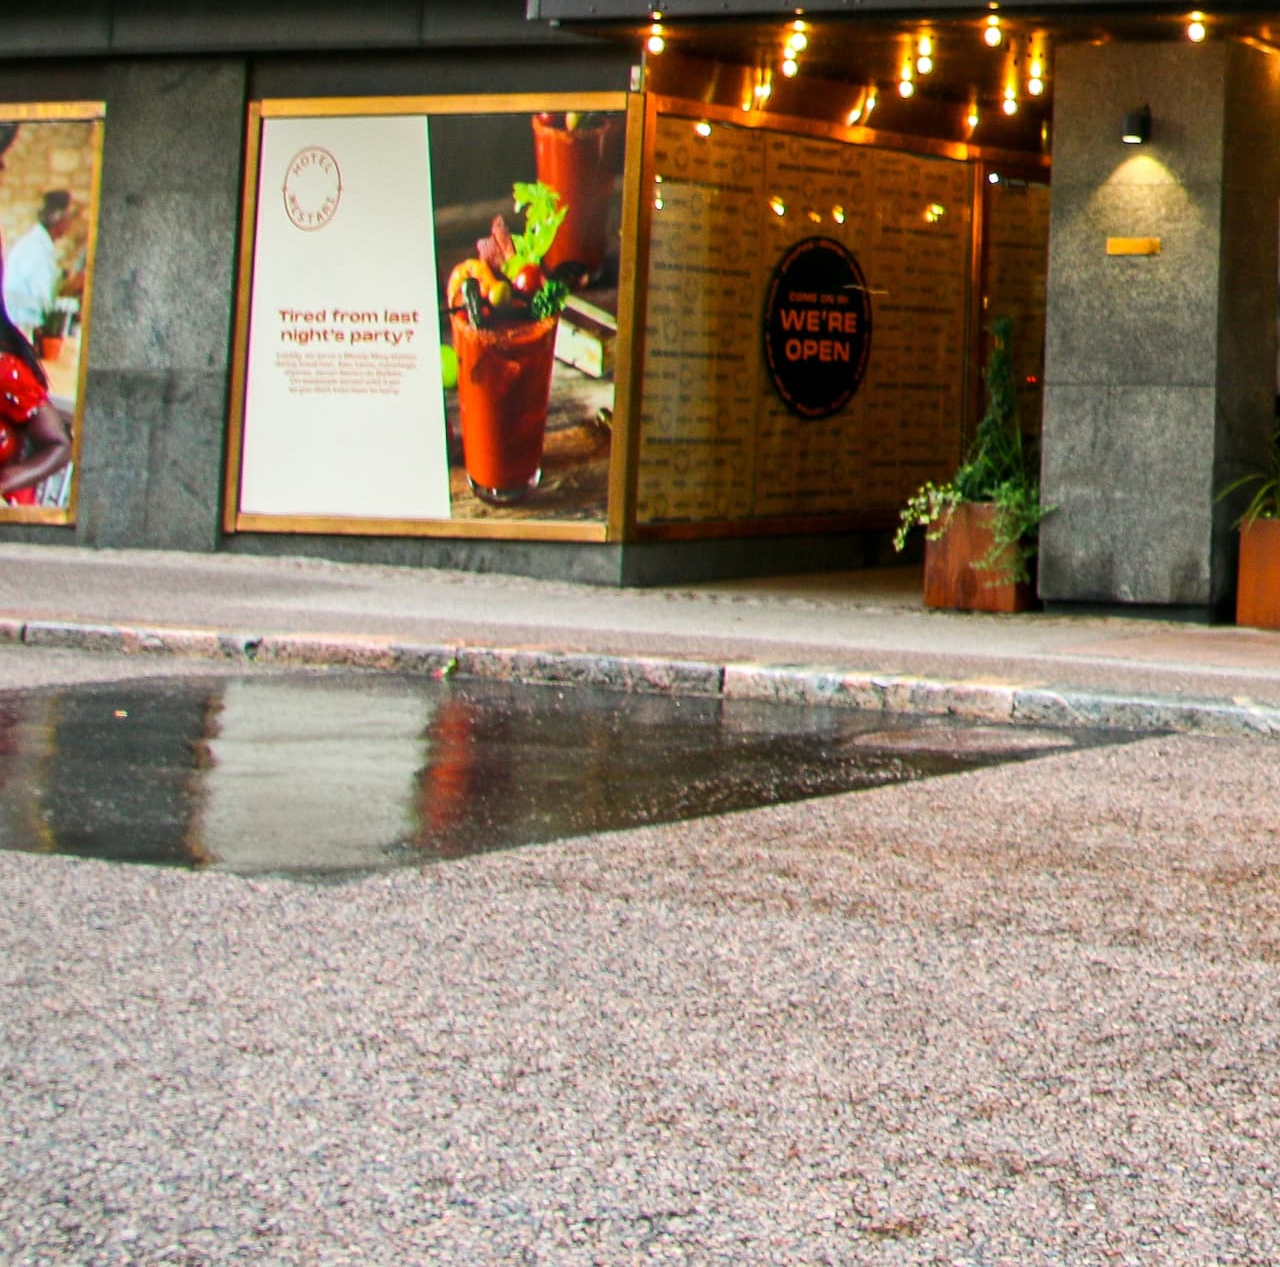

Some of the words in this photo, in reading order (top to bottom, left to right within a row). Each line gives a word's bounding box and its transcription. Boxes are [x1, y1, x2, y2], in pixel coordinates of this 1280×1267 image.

[293, 152, 332, 176] HOTEL
[289, 196, 336, 225] MESTARI
[279, 309, 327, 323] Tired
[332, 309, 379, 323] from
[384, 309, 420, 323] last
[780, 308, 858, 334] WE'RE
[281, 328, 345, 346] night's
[350, 329, 414, 346] party?
[784, 337, 850, 363] OPEN
